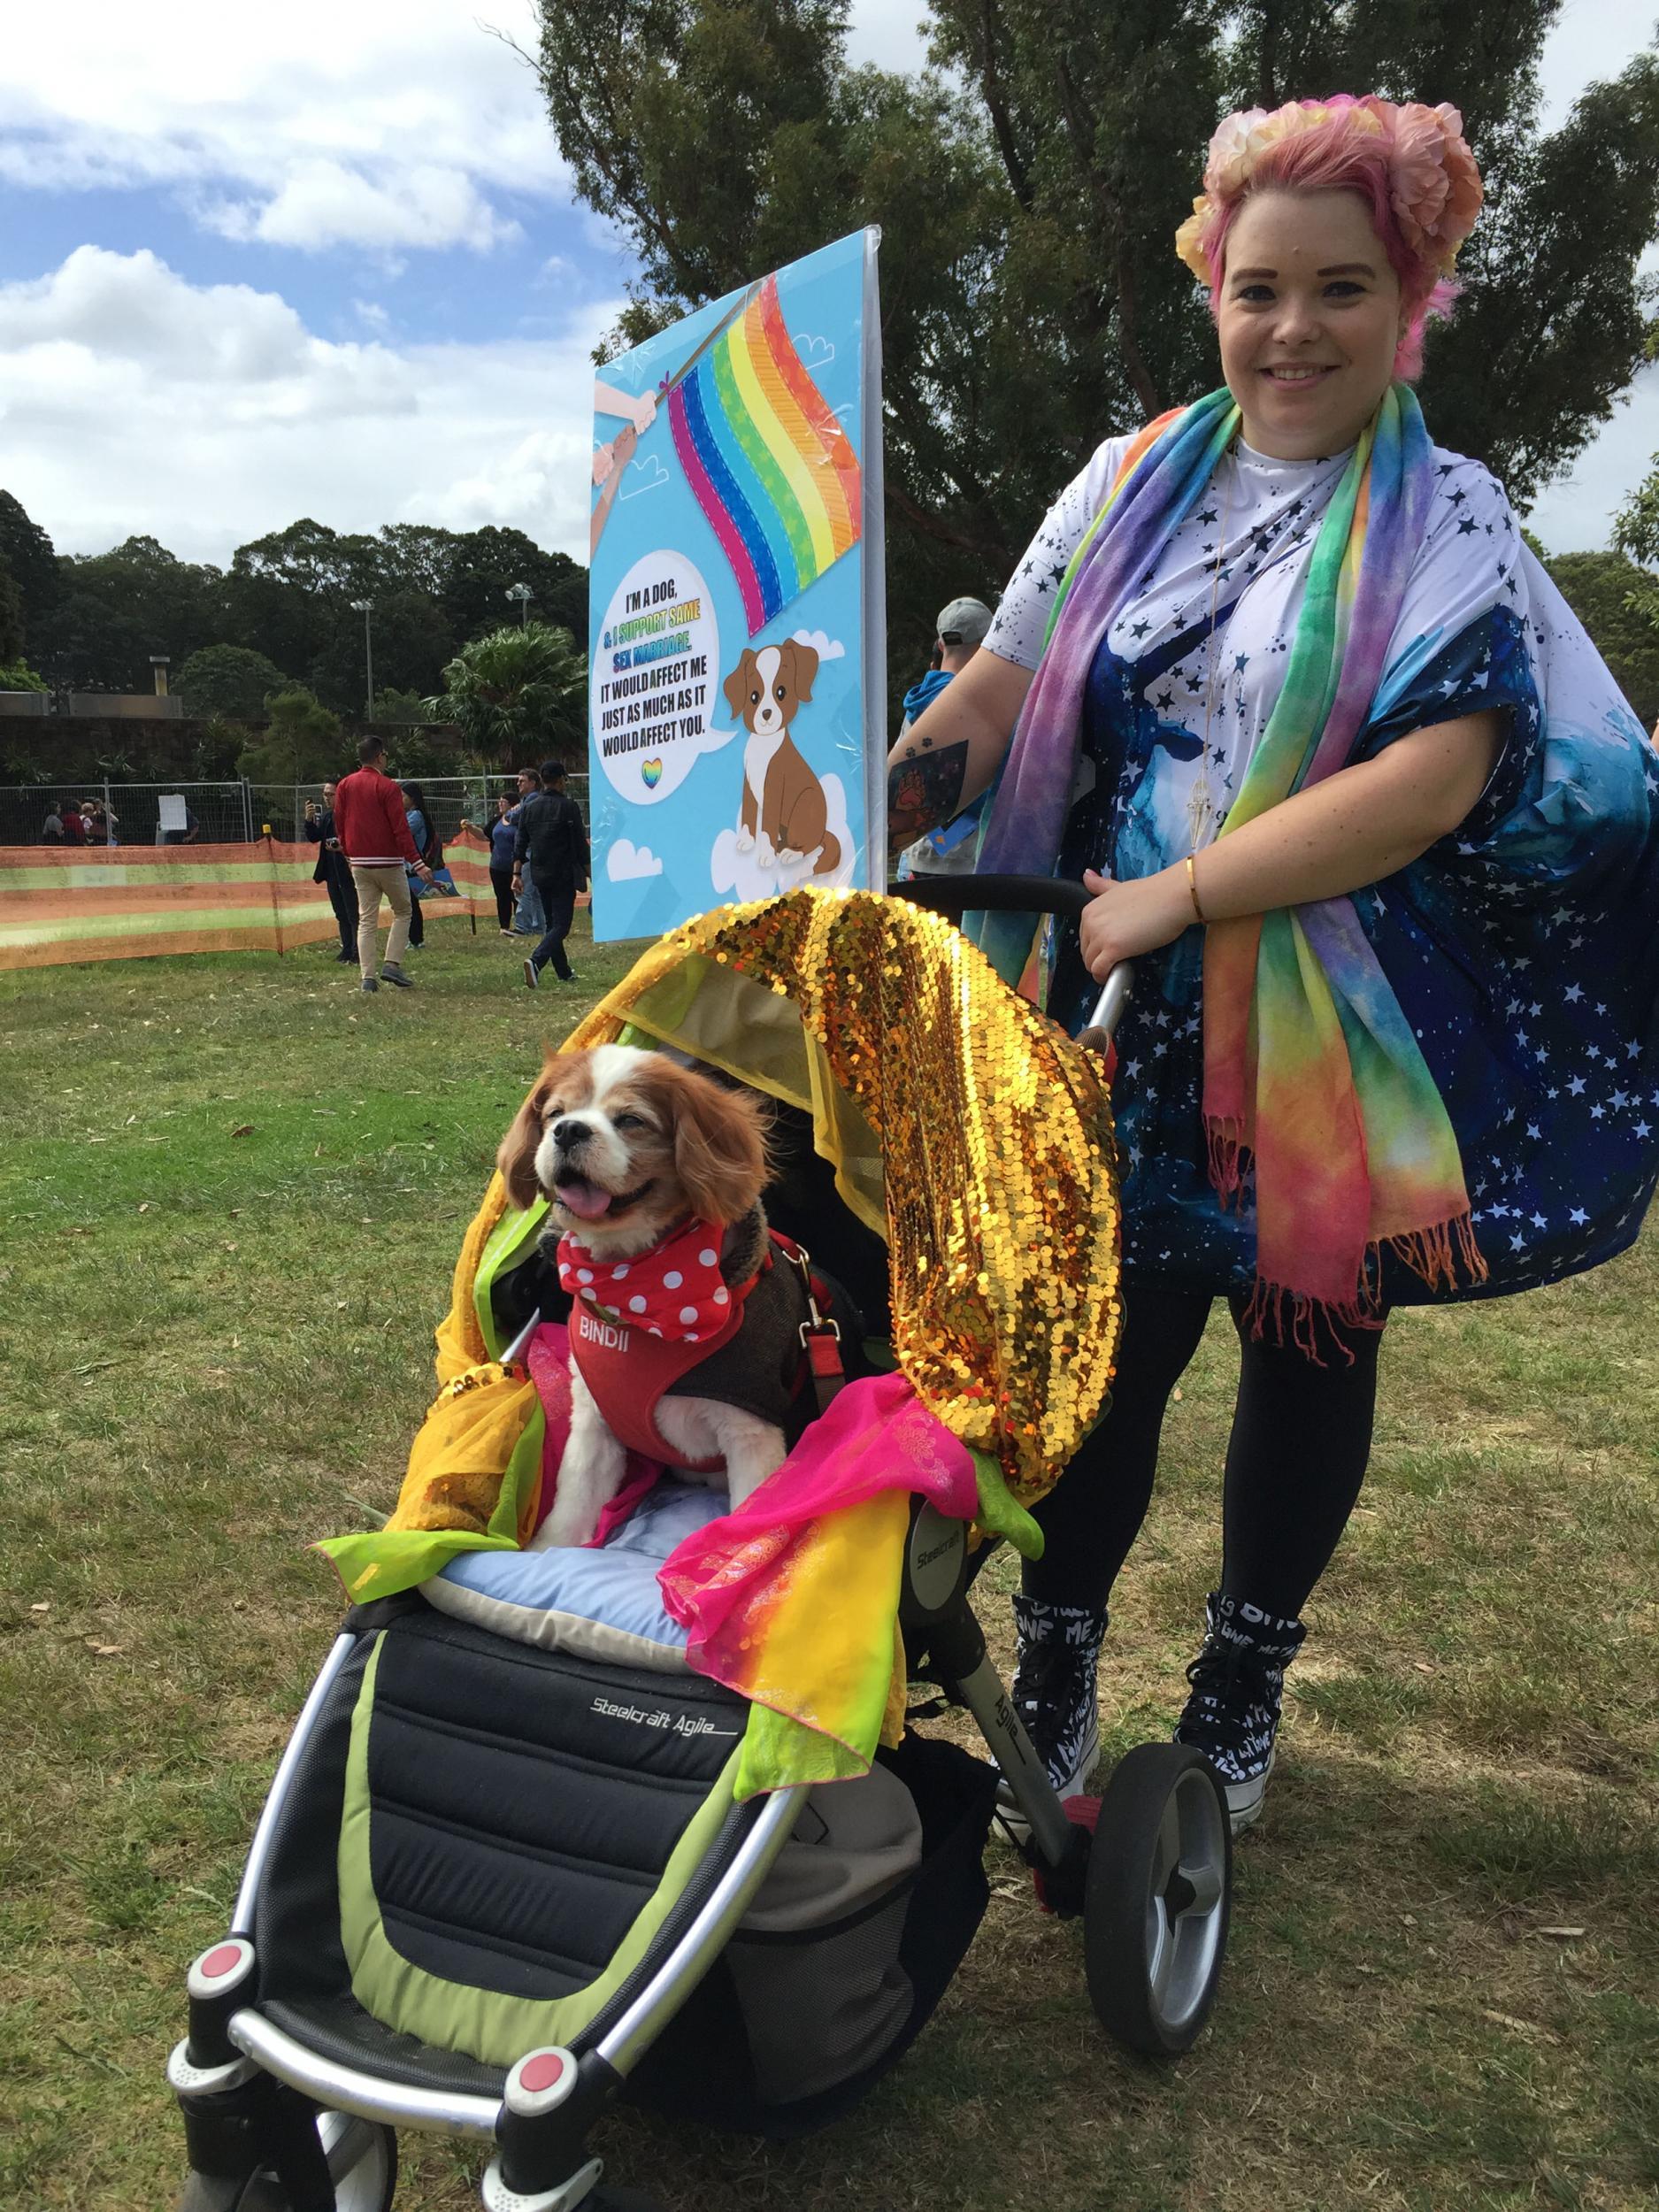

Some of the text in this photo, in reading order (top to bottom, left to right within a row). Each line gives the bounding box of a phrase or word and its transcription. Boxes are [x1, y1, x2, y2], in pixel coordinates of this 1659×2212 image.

[626, 579, 678, 614] I'M A DOG,
[603, 598, 701, 649] & I SUPPORT SAME
[613, 630, 693, 673] SEX MARRIAGE.
[601, 655, 707, 704] IT WOULD AFFECT ME
[602, 684, 706, 731] JUST AS MUCH AS IT
[603, 714, 705, 757] WOULD AFFECT YOU.
[580, 1315, 629, 1353] BINDII
[590, 1697, 739, 1737] Steelcraft Agile
